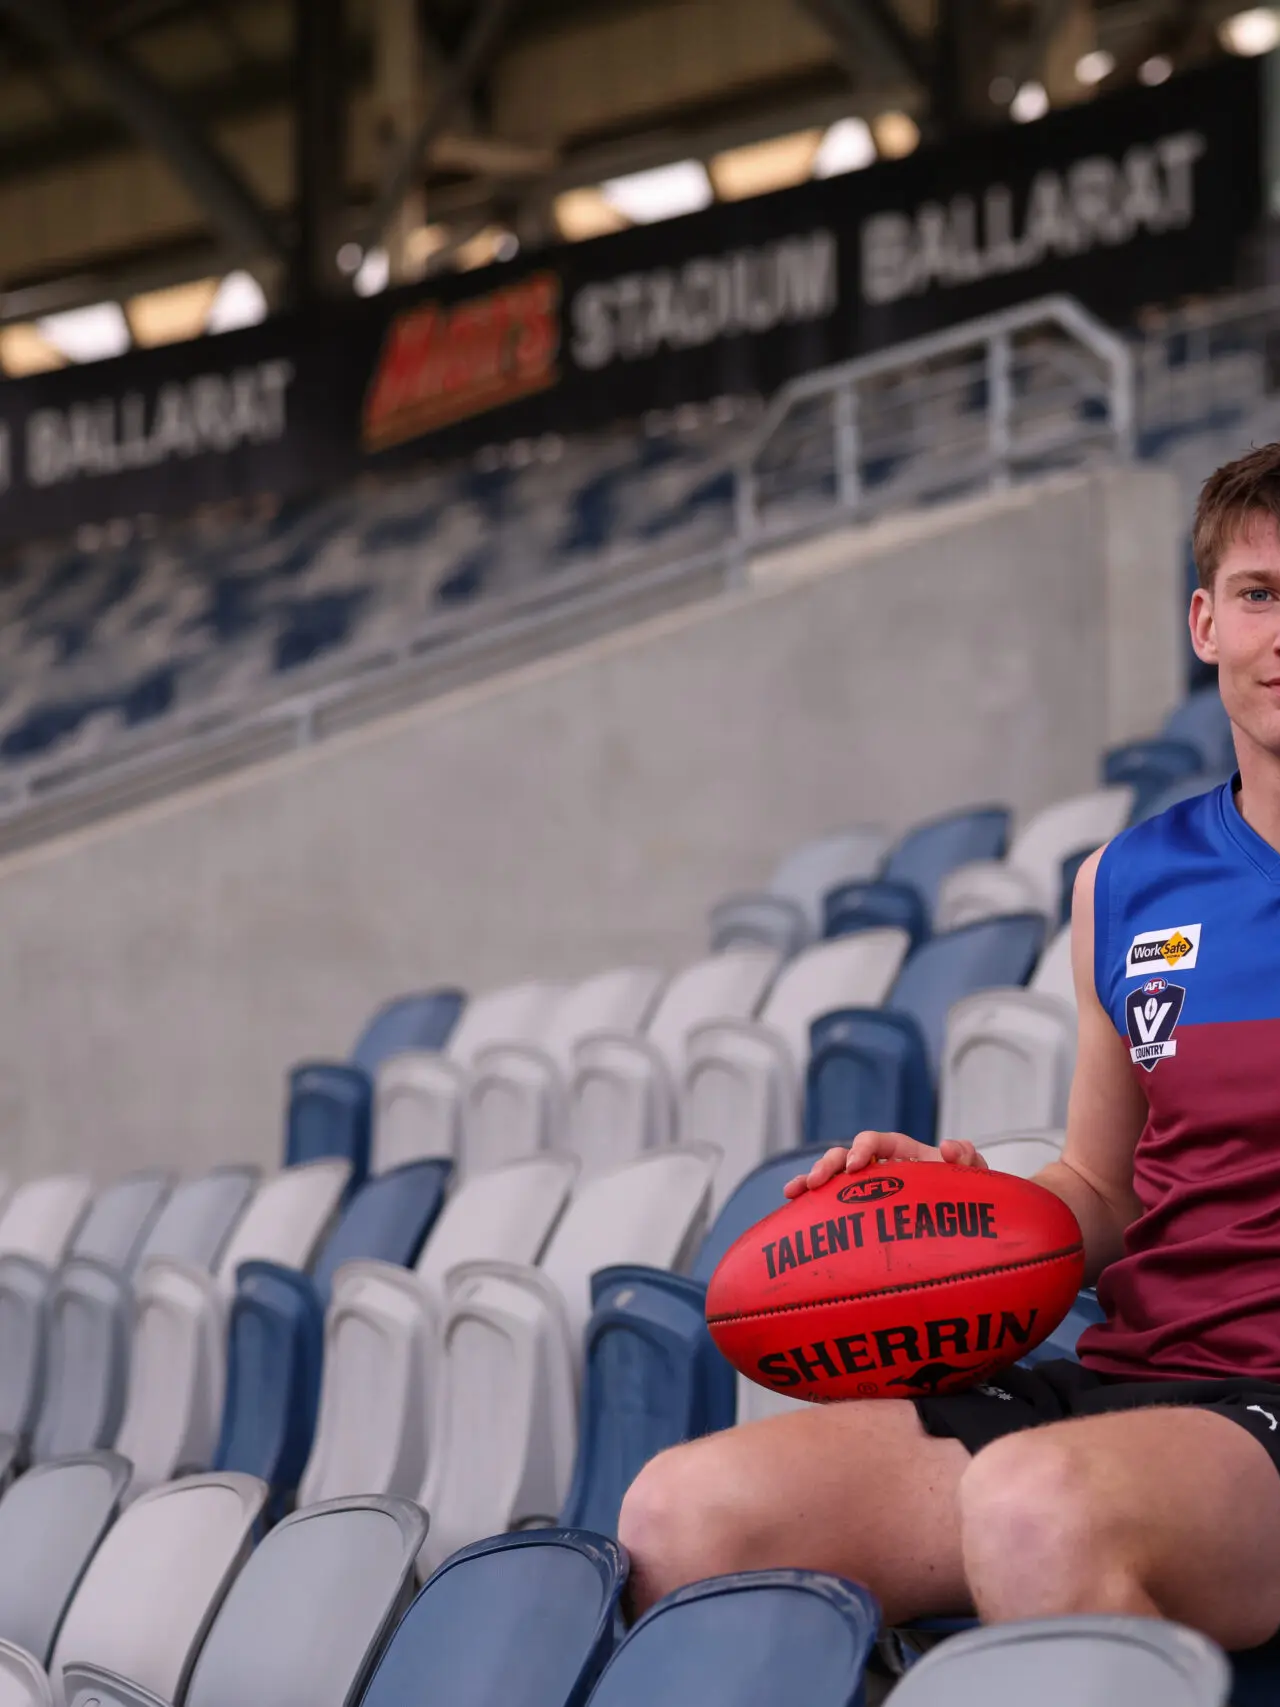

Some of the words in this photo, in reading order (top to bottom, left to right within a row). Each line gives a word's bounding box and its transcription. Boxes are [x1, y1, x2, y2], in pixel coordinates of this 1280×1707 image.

[572, 226, 838, 370] STADIUM
[859, 132, 1205, 304] BALLARAT
[26, 358, 295, 488] BALLARAT
[1134, 942, 1187, 960] WorkSafe
[1144, 980, 1166, 993] AFL
[1135, 1043, 1165, 1060] COUNTRY
[843, 1178, 901, 1200] AFL
[762, 1212, 865, 1279] TALENT
[877, 1201, 998, 1242] LEAGUE
[758, 1308, 1038, 1387] SHERRIN
